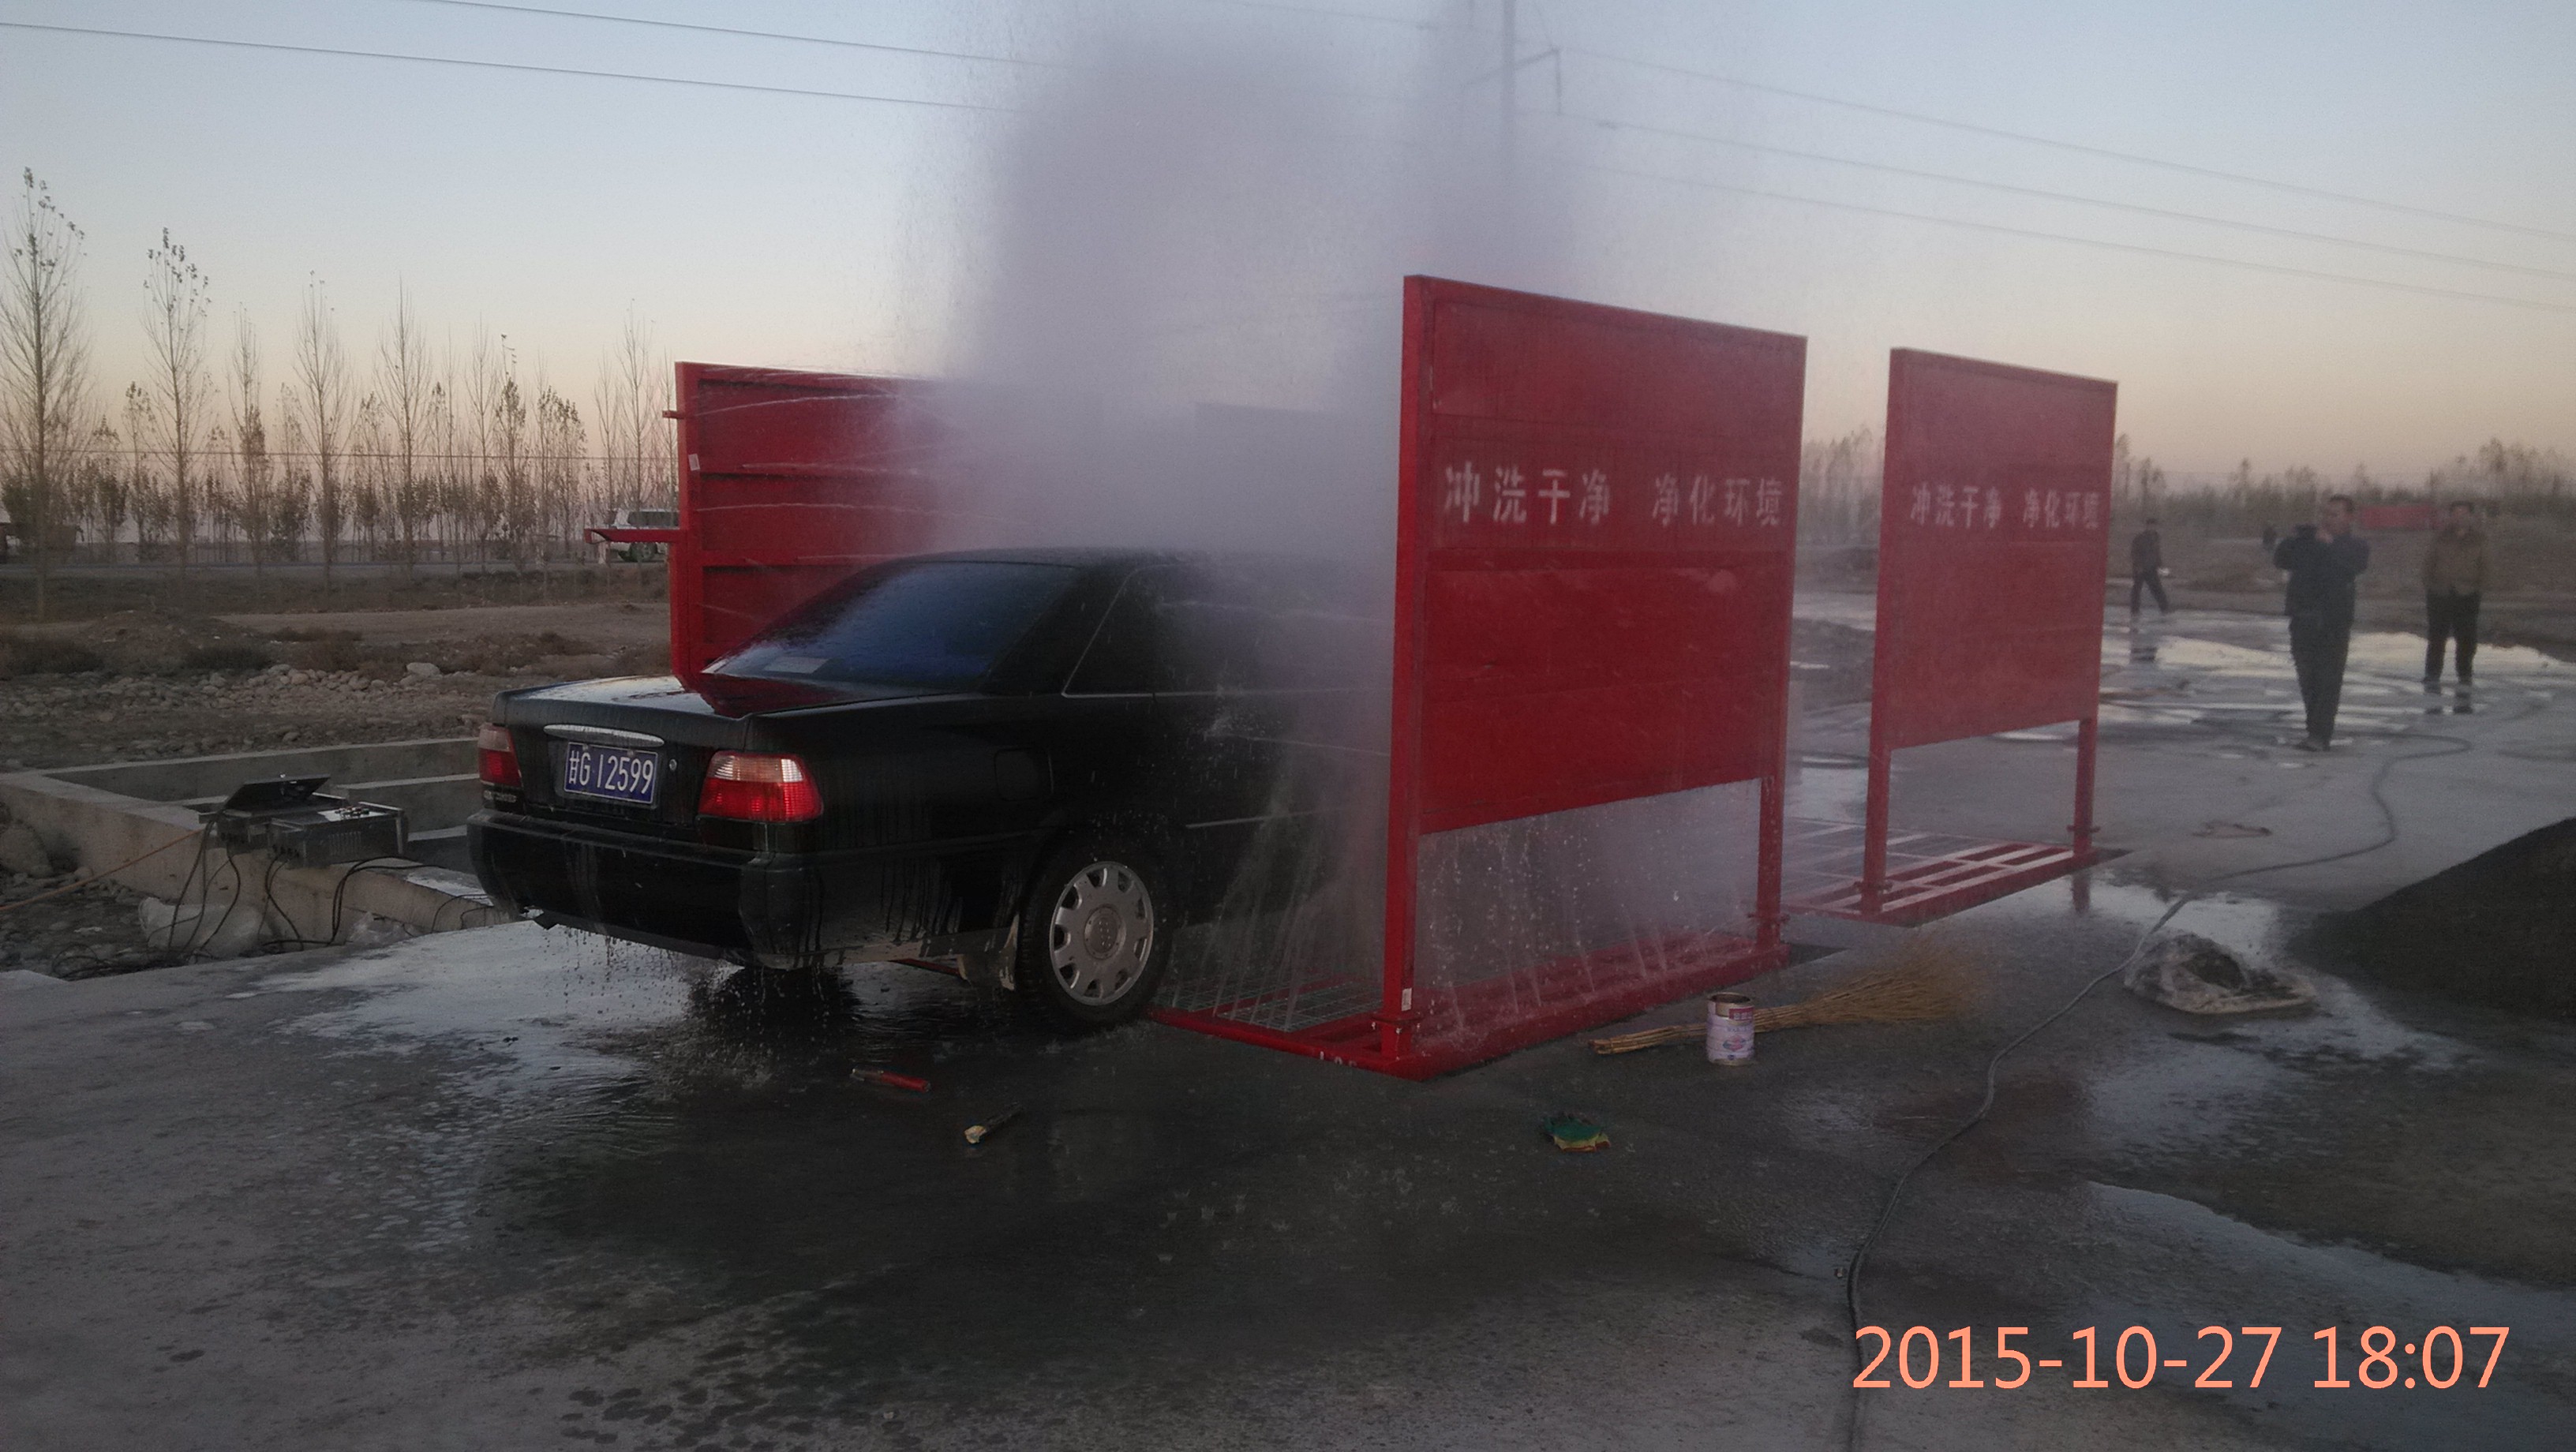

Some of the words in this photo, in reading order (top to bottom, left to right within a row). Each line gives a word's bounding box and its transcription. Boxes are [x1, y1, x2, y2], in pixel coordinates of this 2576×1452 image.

[1443, 460, 1610, 526] 冲洗干净
[1652, 473, 1783, 527] 净化环境
[1910, 481, 2001, 530] 冲洗干净
